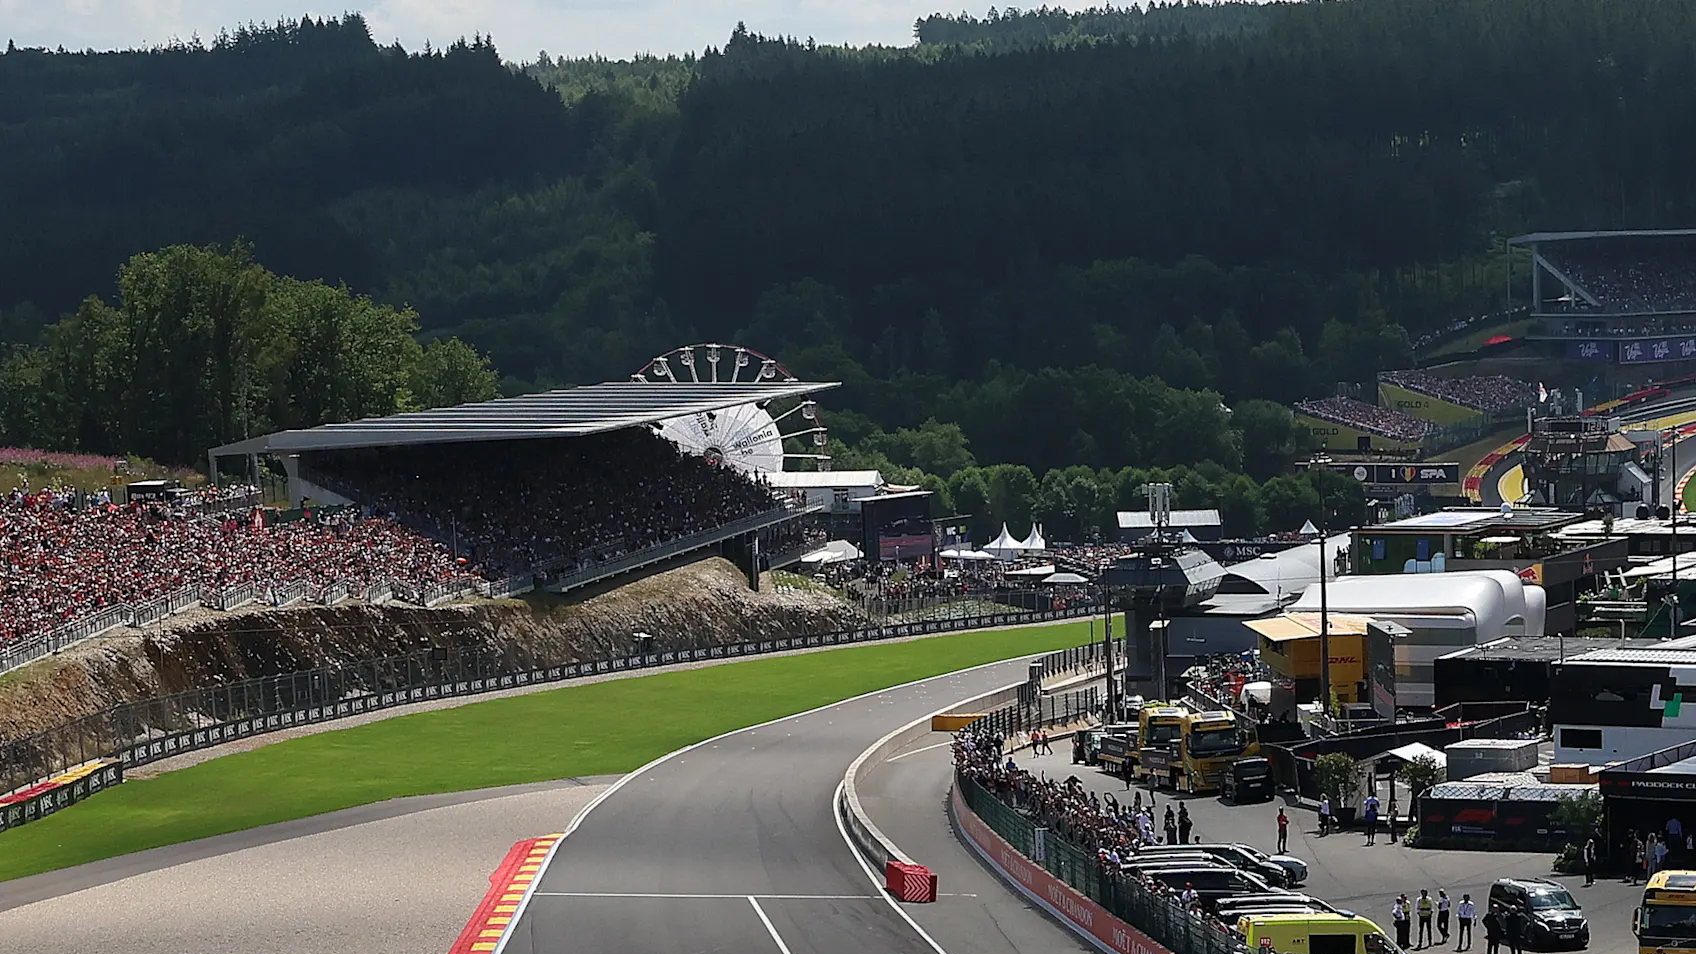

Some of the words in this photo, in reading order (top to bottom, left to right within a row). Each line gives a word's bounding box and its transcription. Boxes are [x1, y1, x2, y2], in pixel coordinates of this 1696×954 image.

[733, 430, 773, 449] Wallonia
[1420, 469, 1446, 479] SPA
[1236, 546, 1261, 556] MSC
[1631, 780, 1684, 789] PADDOCK
